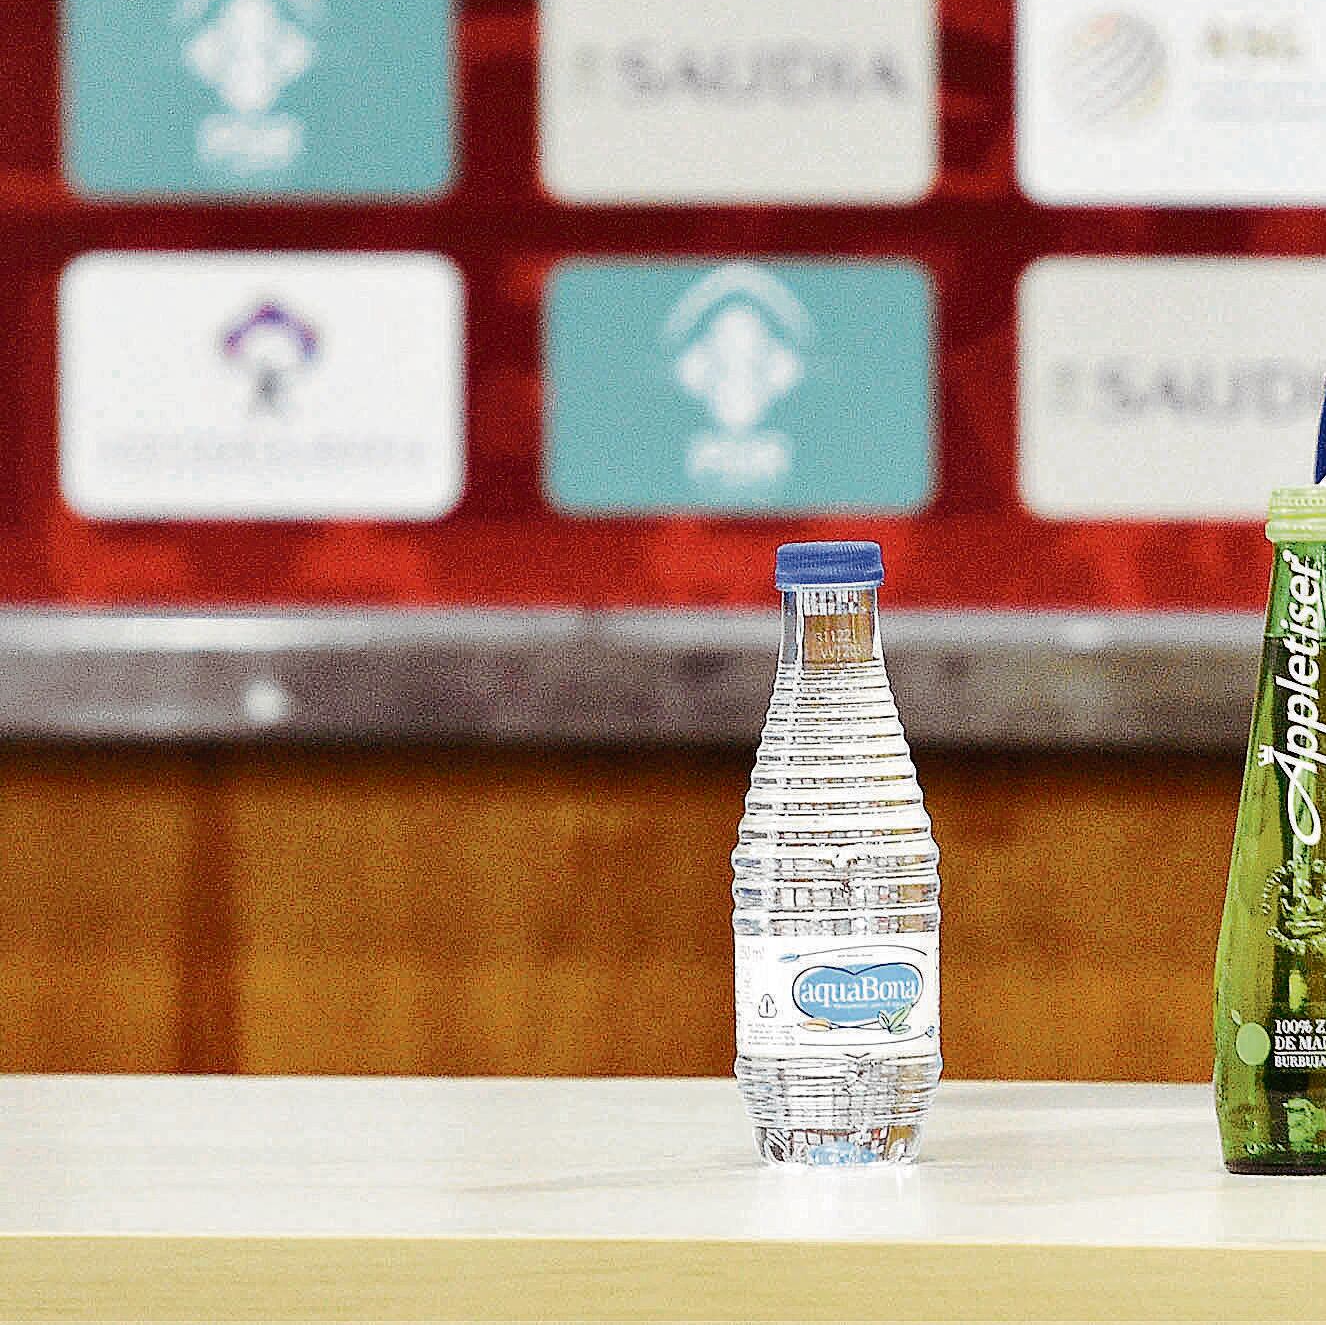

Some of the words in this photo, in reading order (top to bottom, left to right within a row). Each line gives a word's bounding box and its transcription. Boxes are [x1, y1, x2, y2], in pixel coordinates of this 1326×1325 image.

[1098, 356, 1321, 419] SAUD
[801, 976, 917, 1008] aquaBona
[1274, 1018, 1313, 1035] 100%
[1274, 1035, 1298, 1051] DE
